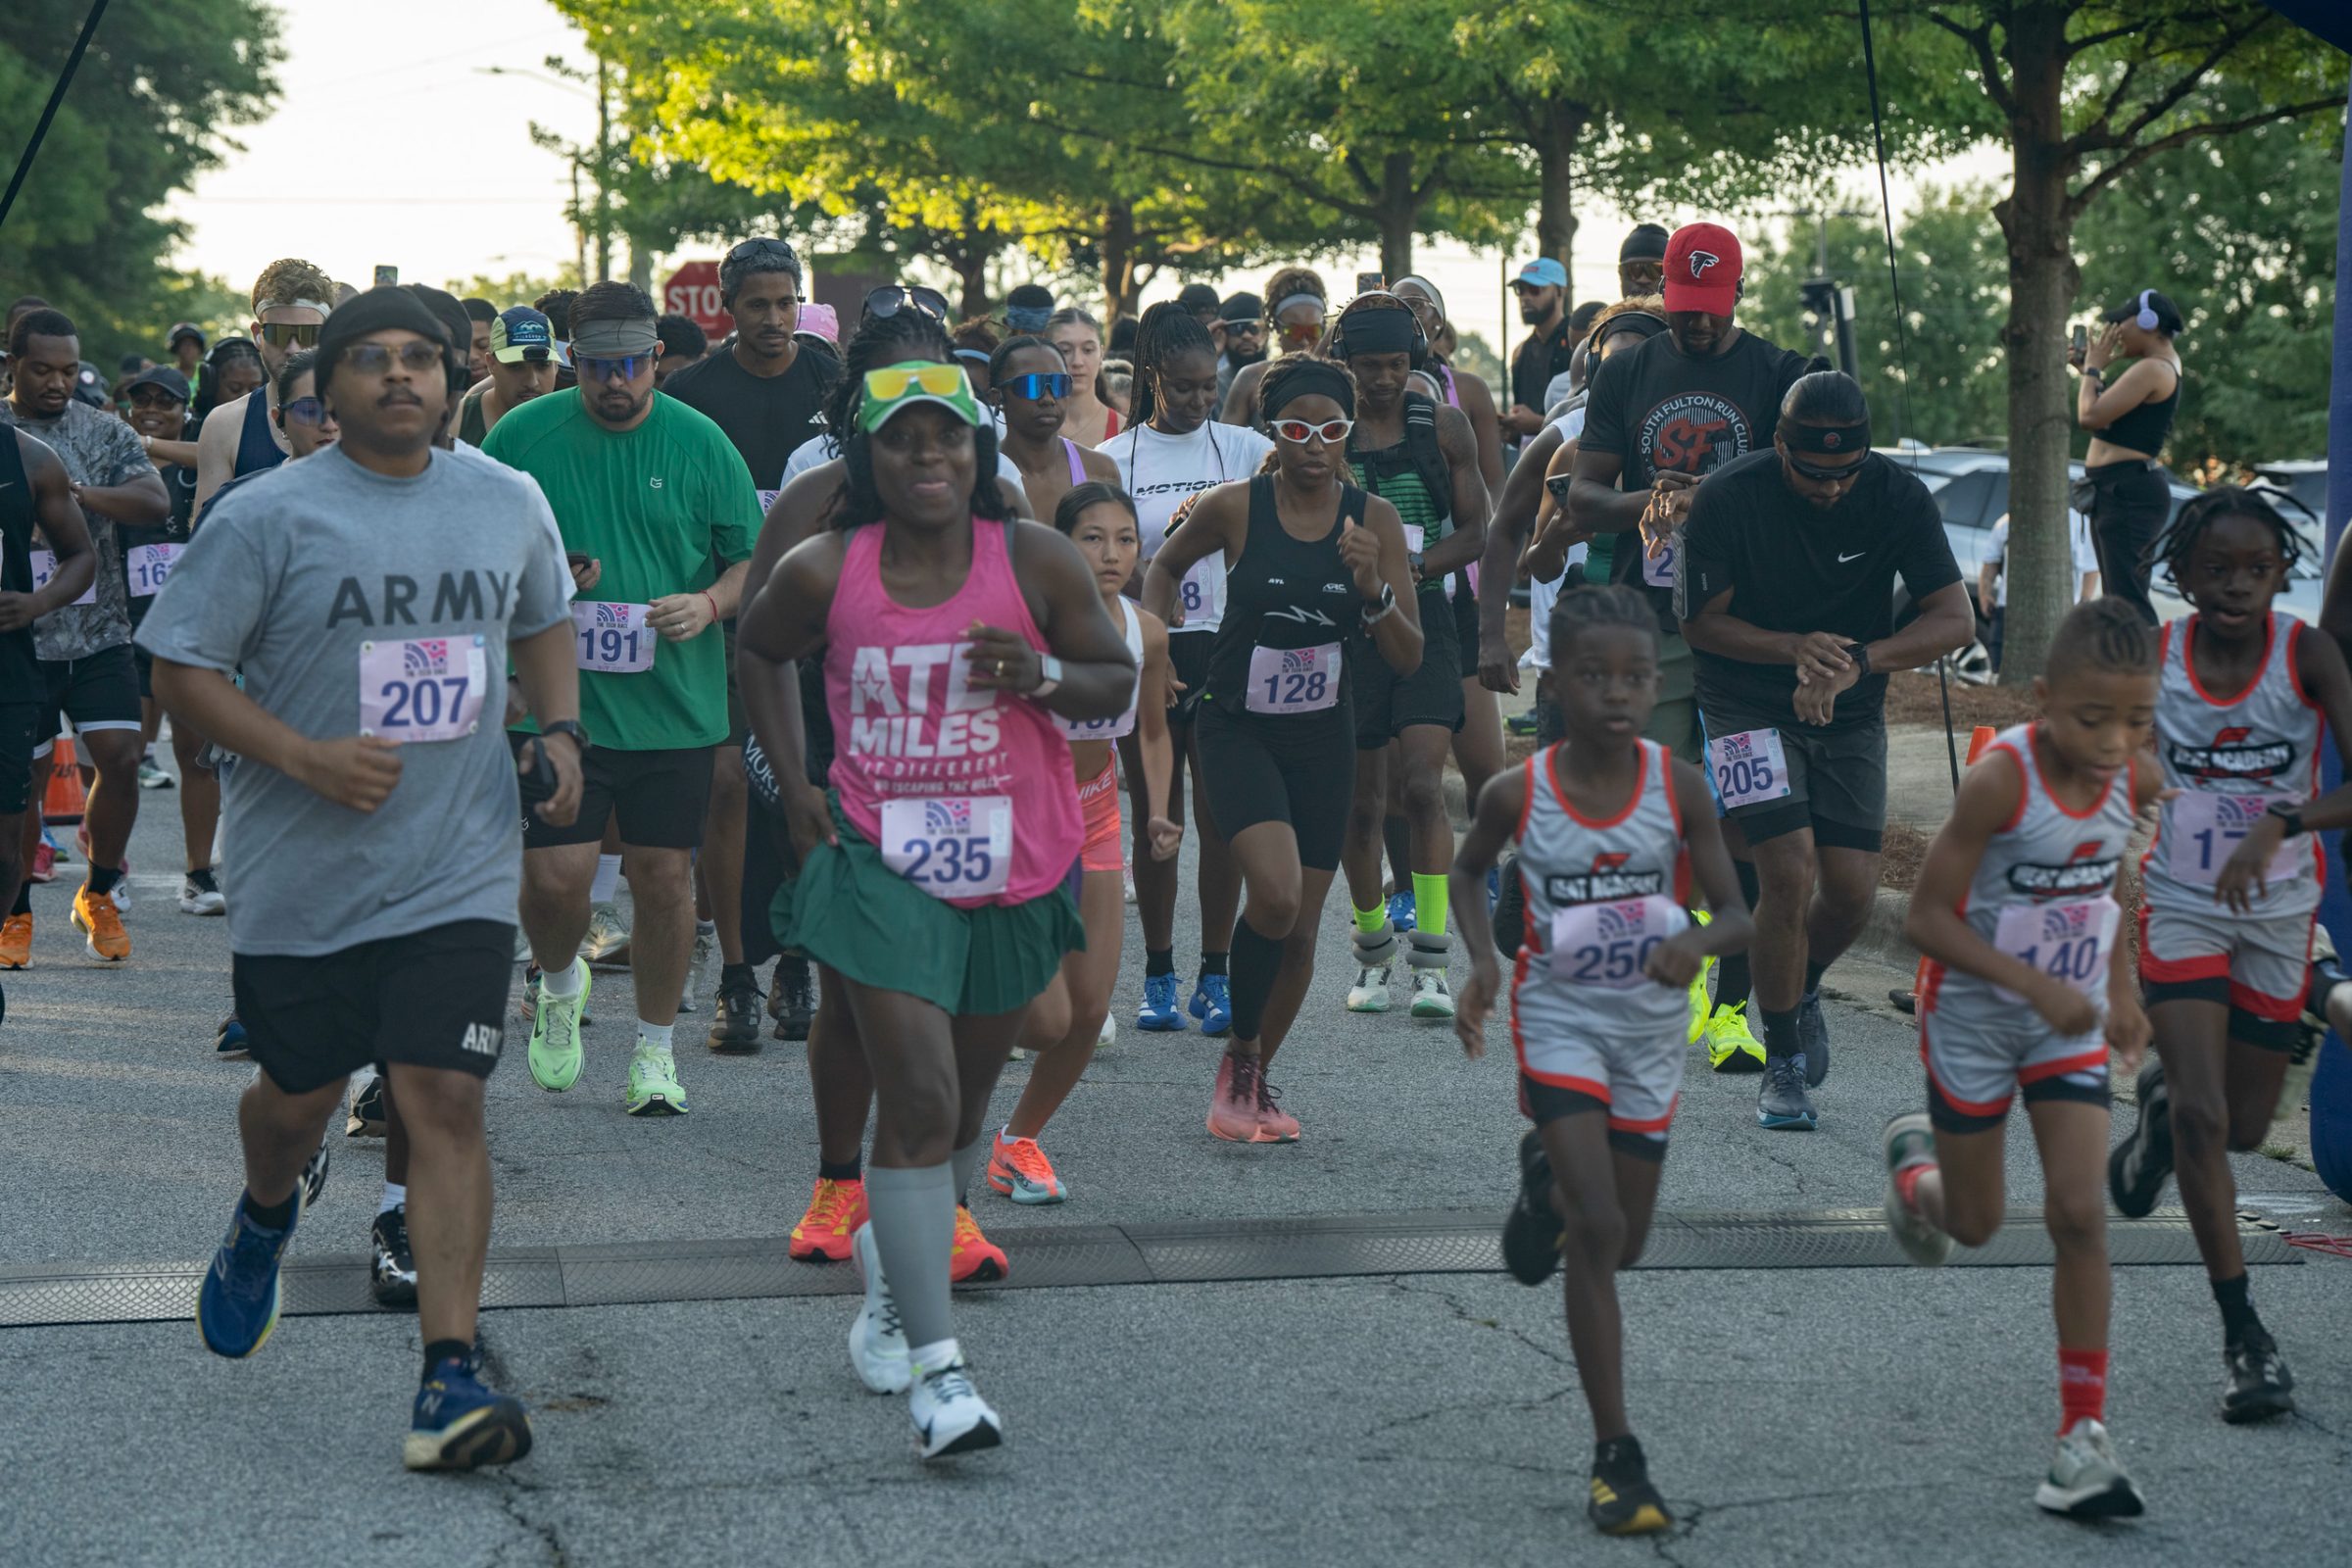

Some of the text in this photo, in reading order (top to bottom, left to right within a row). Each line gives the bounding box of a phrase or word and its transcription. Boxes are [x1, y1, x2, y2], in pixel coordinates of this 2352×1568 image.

[668, 284, 720, 317] STO
[1642, 396, 1747, 456] SOUTH FULTON RUN CLUB
[1653, 418, 1727, 470] SF
[1135, 480, 1222, 496] MOTION
[137, 562, 172, 587] 16
[326, 569, 511, 628] ARMY
[580, 628, 638, 662] 191
[380, 677, 469, 727] 207
[1264, 671, 1328, 705] 128
[849, 708, 1001, 759] MILES
[1719, 756, 1773, 799] 205
[903, 836, 992, 883] 235
